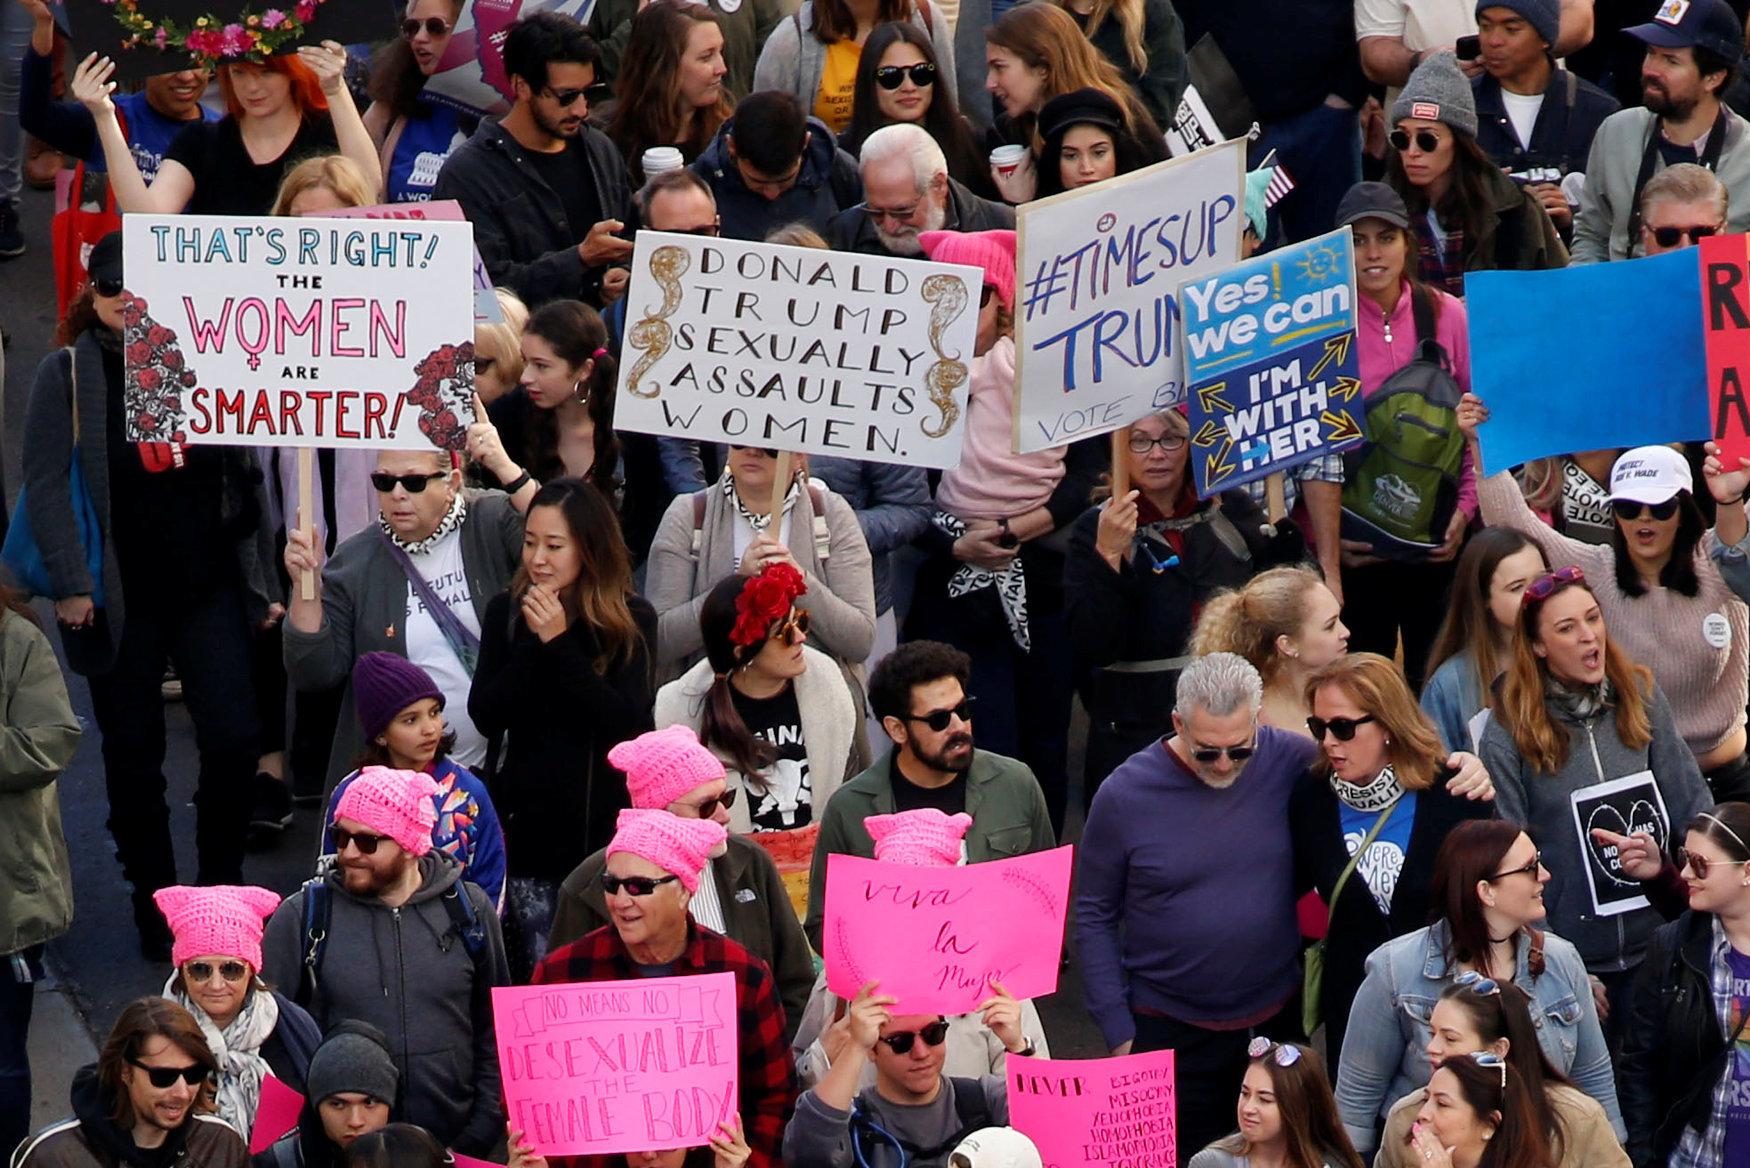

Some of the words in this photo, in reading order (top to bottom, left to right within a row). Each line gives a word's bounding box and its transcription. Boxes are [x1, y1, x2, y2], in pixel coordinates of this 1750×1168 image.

[150, 225, 287, 265] THAT'S
[299, 229, 440, 269] RIGHT!
[701, 247, 909, 295] DONALD
[1023, 194, 1237, 322] #TIMESUP
[276, 275, 323, 290] THE
[182, 296, 407, 369] WOMEN
[694, 285, 907, 335] TRUMP
[1187, 318, 1260, 359] we
[1262, 283, 1350, 341] can
[281, 366, 319, 380] ARE
[674, 323, 926, 376] SEXUALLY
[670, 363, 914, 414] ASSAULTS
[1248, 358, 1302, 405] I'M
[189, 388, 408, 440] SMARTER!
[661, 400, 909, 456] WOMEN.
[1037, 394, 1134, 442] VOTE
[1223, 381, 1329, 441] WITH
[1240, 414, 1322, 472] HER
[929, 920, 979, 954] la
[545, 995, 568, 1020] NO
[579, 991, 630, 1016] MEANS
[643, 990, 669, 1015] NO
[934, 963, 1022, 1000] Mujer
[508, 1026, 730, 1081] DESEXUALIZE
[585, 1075, 642, 1095] THE
[1016, 1073, 1090, 1097] NEVER
[515, 1095, 624, 1144] FEMALE
[642, 1080, 733, 1142] BODY
